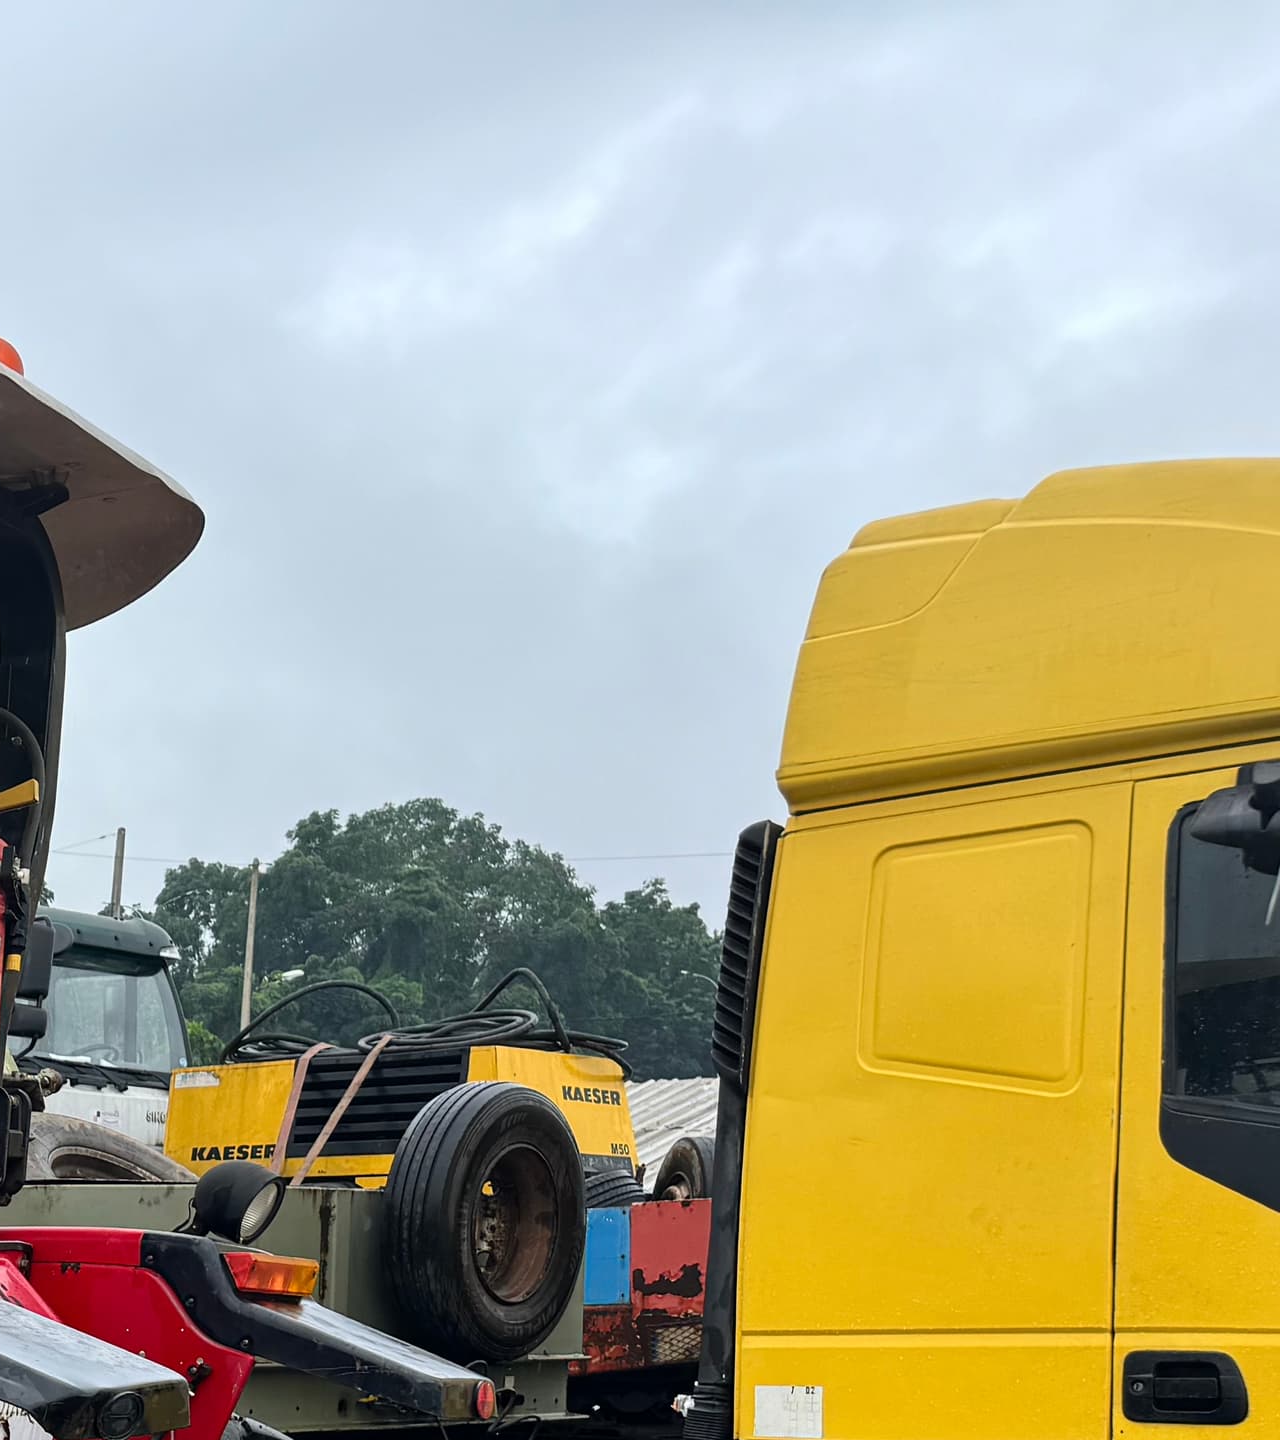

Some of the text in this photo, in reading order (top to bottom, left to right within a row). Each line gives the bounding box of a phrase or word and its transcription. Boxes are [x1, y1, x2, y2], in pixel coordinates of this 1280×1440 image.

[561, 1085, 622, 1106] KAESER
[191, 1144, 277, 1162] KAESER
[610, 1143, 630, 1156] M50
